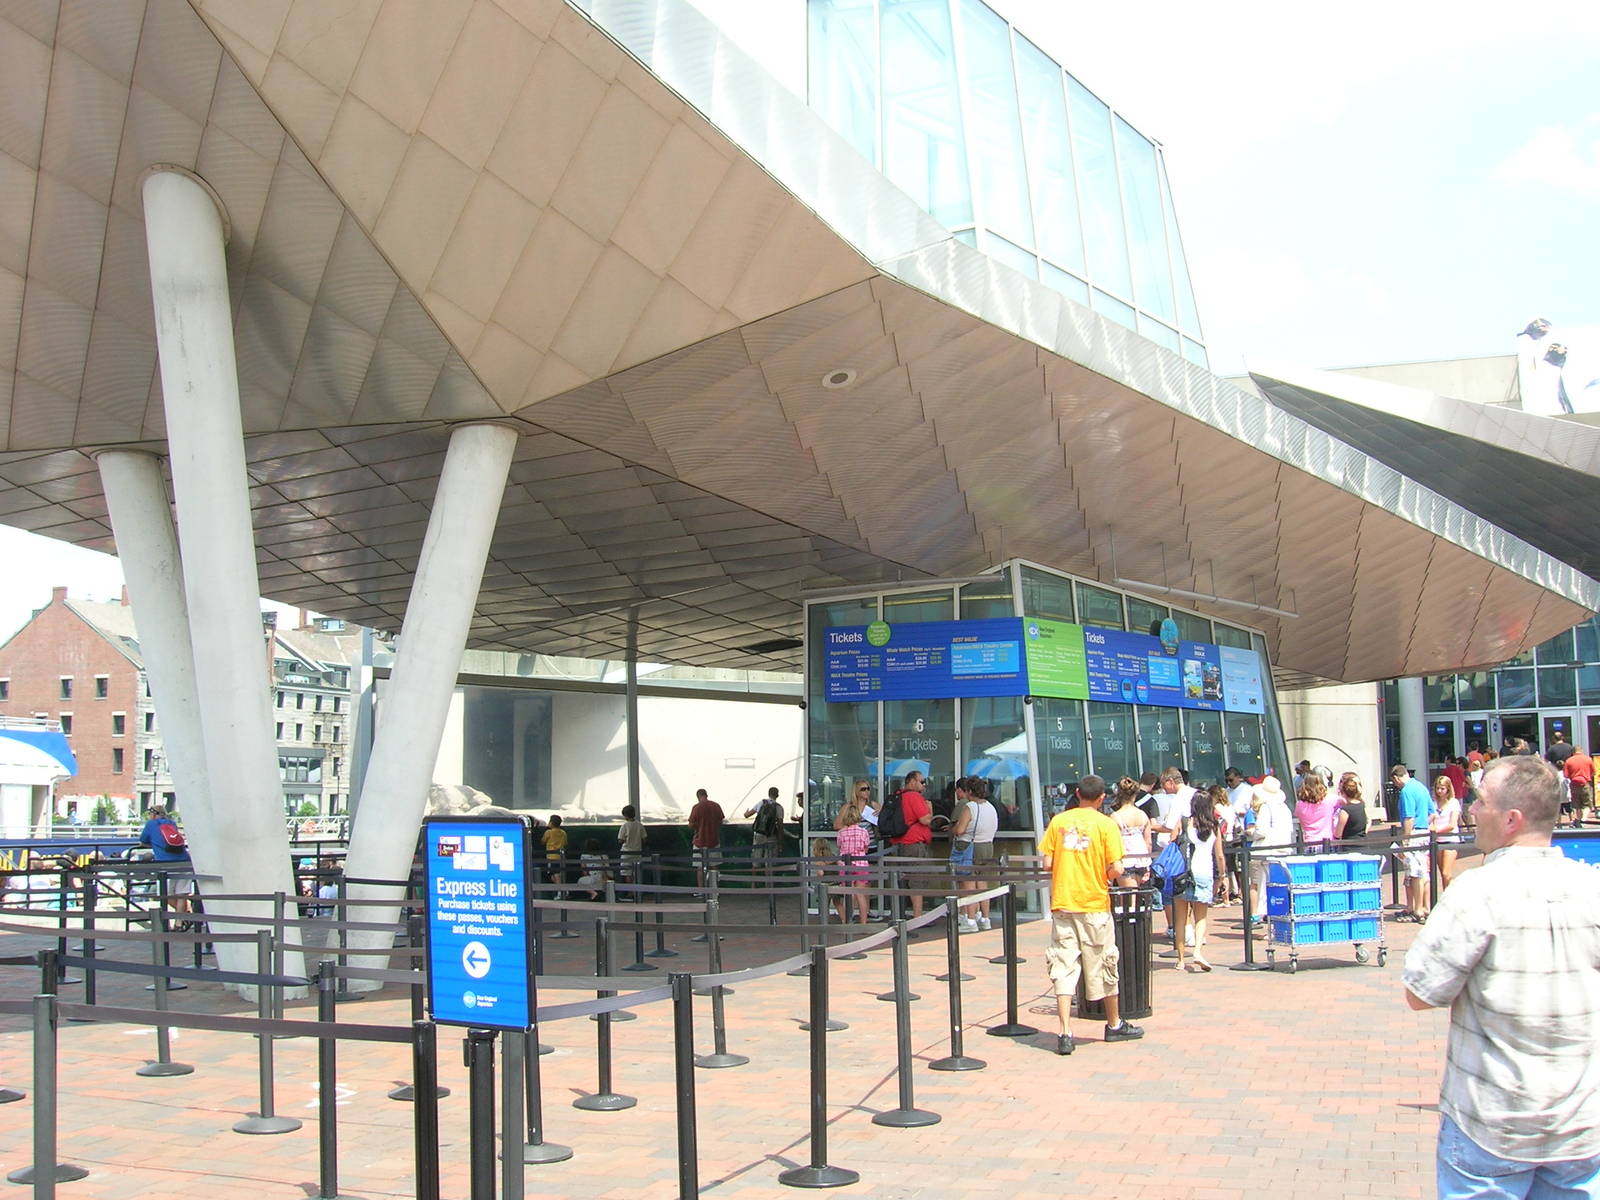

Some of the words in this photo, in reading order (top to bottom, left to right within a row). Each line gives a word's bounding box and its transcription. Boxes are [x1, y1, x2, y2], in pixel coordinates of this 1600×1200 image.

[830, 632, 863, 643] Tickets
[1085, 632, 1105, 645] Tickets
[916, 718, 924, 732] 6
[1057, 717, 1063, 731] 5
[1109, 719, 1115, 733] 4
[1157, 721, 1162, 735] 3
[1200, 721, 1206, 735] 2
[1240, 726, 1245, 738] 1
[901, 737, 938, 751] Tickets
[1049, 735, 1072, 749] Tickets
[1103, 737, 1123, 751] Tickets
[1151, 738, 1170, 752] Tickets
[1195, 740, 1212, 753] Tickets
[1235, 742, 1252, 754] Tickets
[436, 877, 487, 898] Express
[489, 879, 517, 897] Line
[438, 898, 470, 910] Purchase
[471, 900, 495, 911] tickets
[497, 902, 517, 914] using
[437, 911, 457, 921] these
[458, 913, 485, 924] passes,
[486, 914, 519, 925] vouchers
[452, 924, 466, 934] and
[467, 925, 503, 936] discounts.
